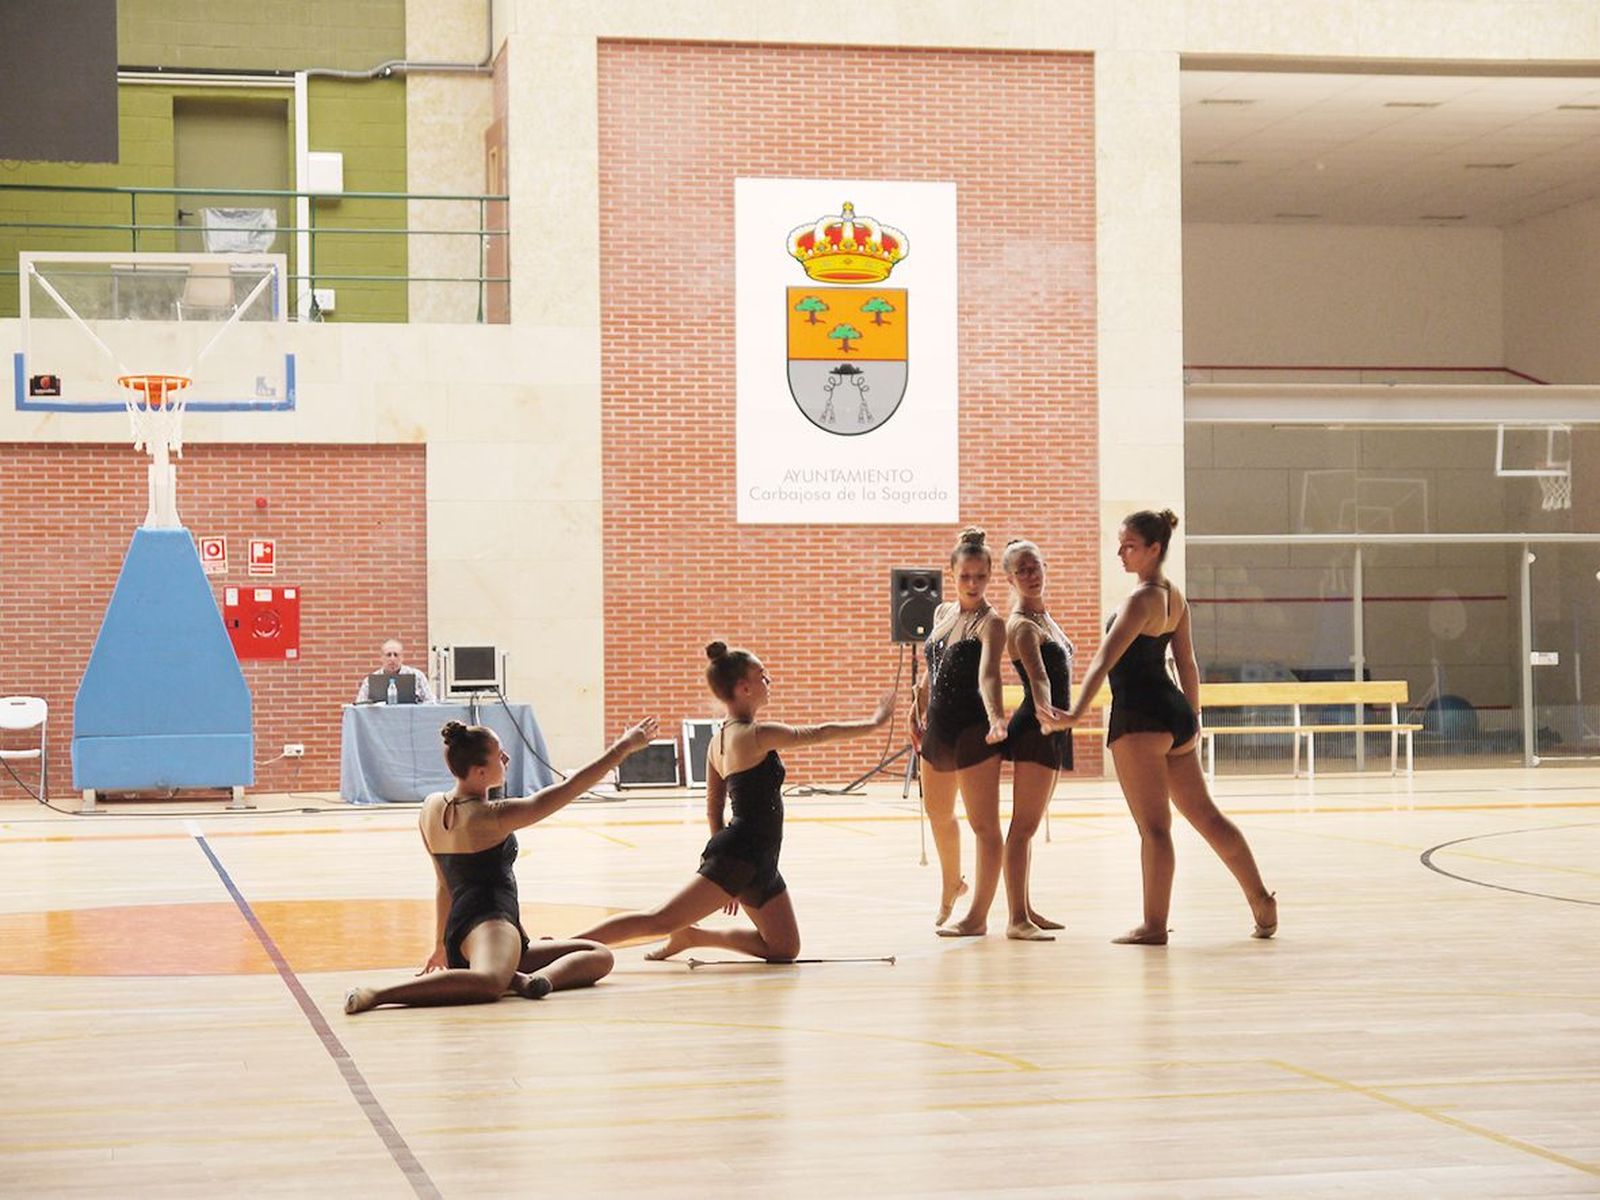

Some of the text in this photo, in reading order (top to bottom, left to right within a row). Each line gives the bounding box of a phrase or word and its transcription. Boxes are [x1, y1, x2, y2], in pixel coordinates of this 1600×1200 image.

[783, 469, 914, 483] AYUNTAMIENTO
[749, 486, 948, 504] Carbajosa de la Sagrada
